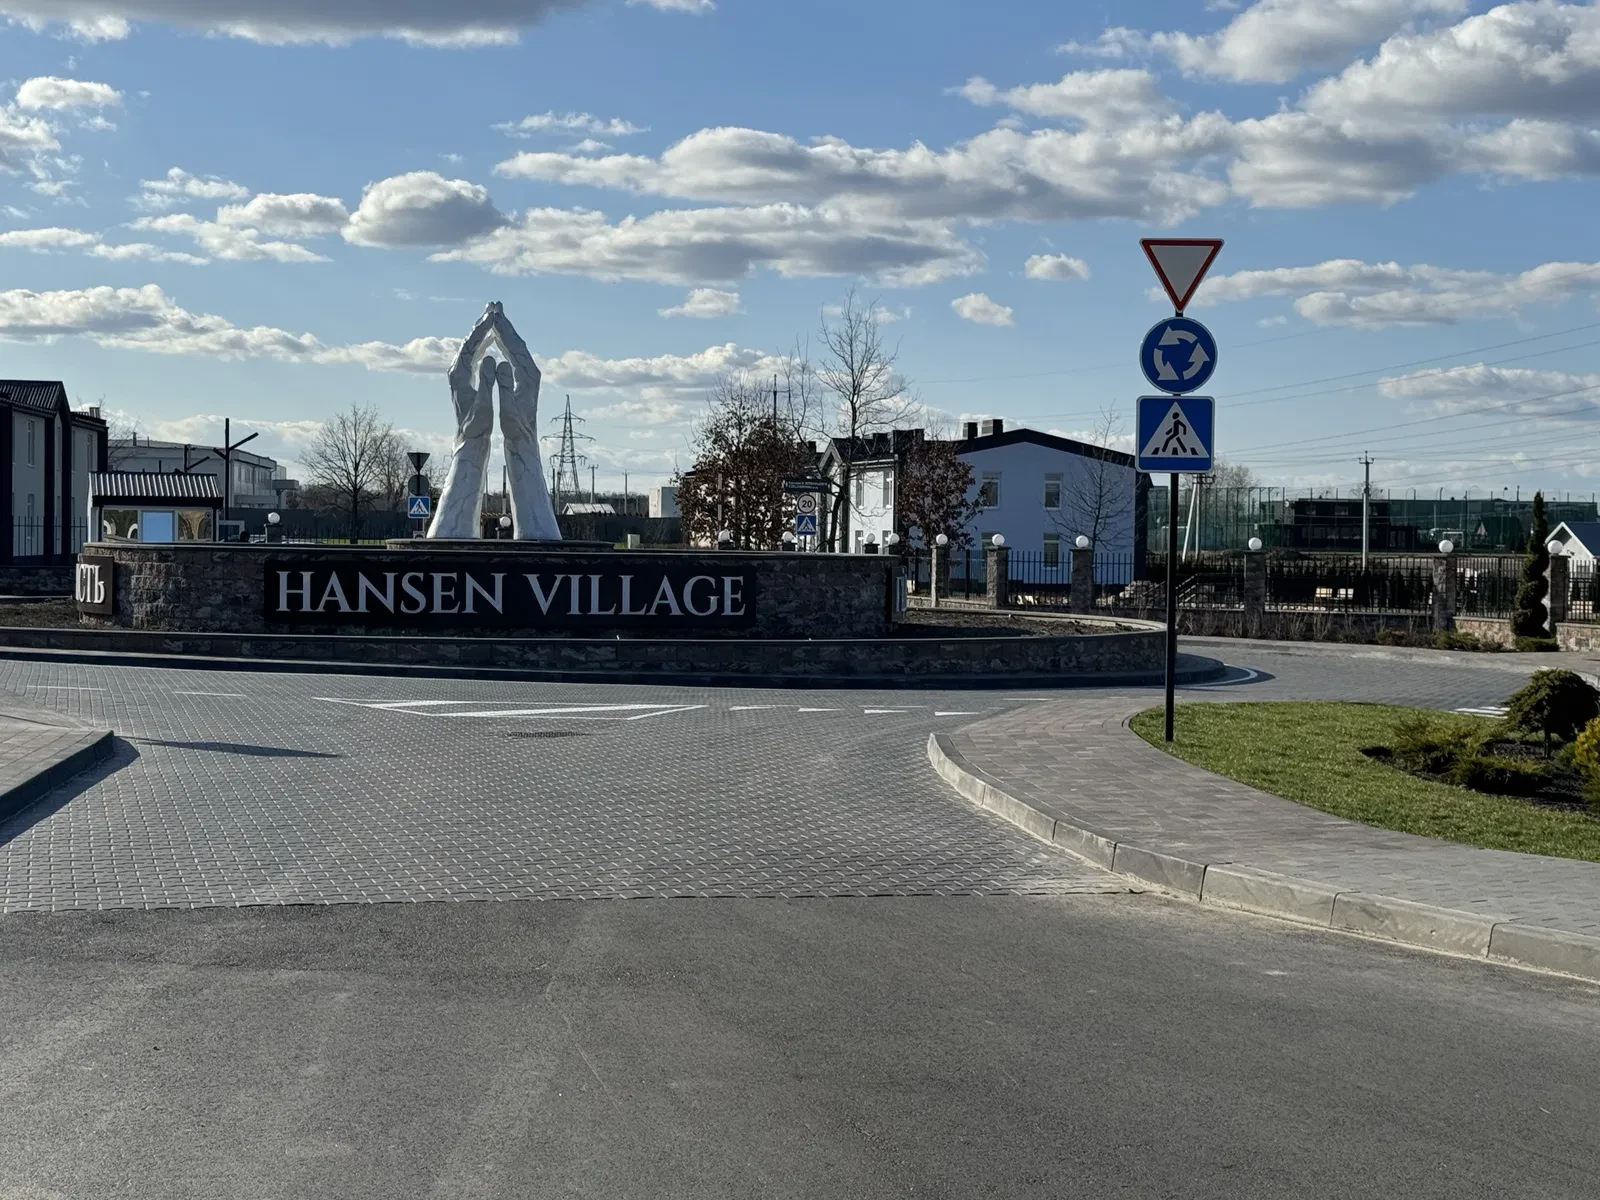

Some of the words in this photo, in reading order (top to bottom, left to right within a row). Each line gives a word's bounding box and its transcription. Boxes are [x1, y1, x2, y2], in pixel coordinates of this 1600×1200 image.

[801, 499, 813, 508] 20
[75, 563, 105, 604] СТЬ
[275, 570, 508, 614] HANSEN
[522, 573, 747, 617] VILLAGE
